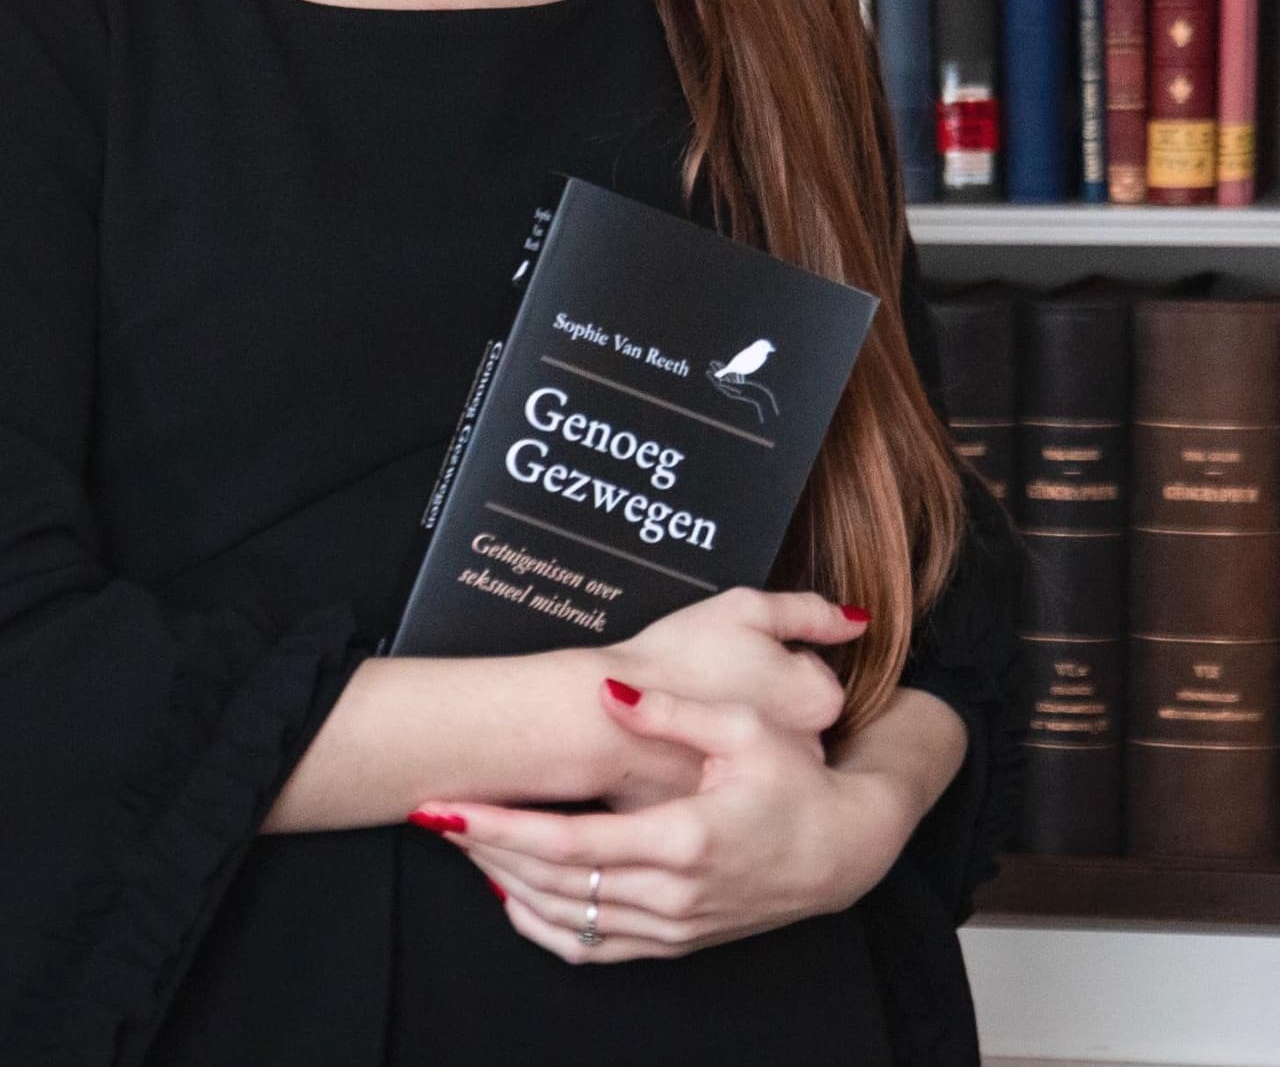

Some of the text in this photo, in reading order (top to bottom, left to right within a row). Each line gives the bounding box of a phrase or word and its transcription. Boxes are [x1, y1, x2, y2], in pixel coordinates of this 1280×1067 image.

[553, 312, 689, 377] Sophie Van Reeth
[524, 387, 686, 490] Genoeg
[505, 438, 717, 551] Gezwegen
[457, 568, 607, 632] seksueel misbruik
[472, 533, 623, 601] Getuigenissen over
